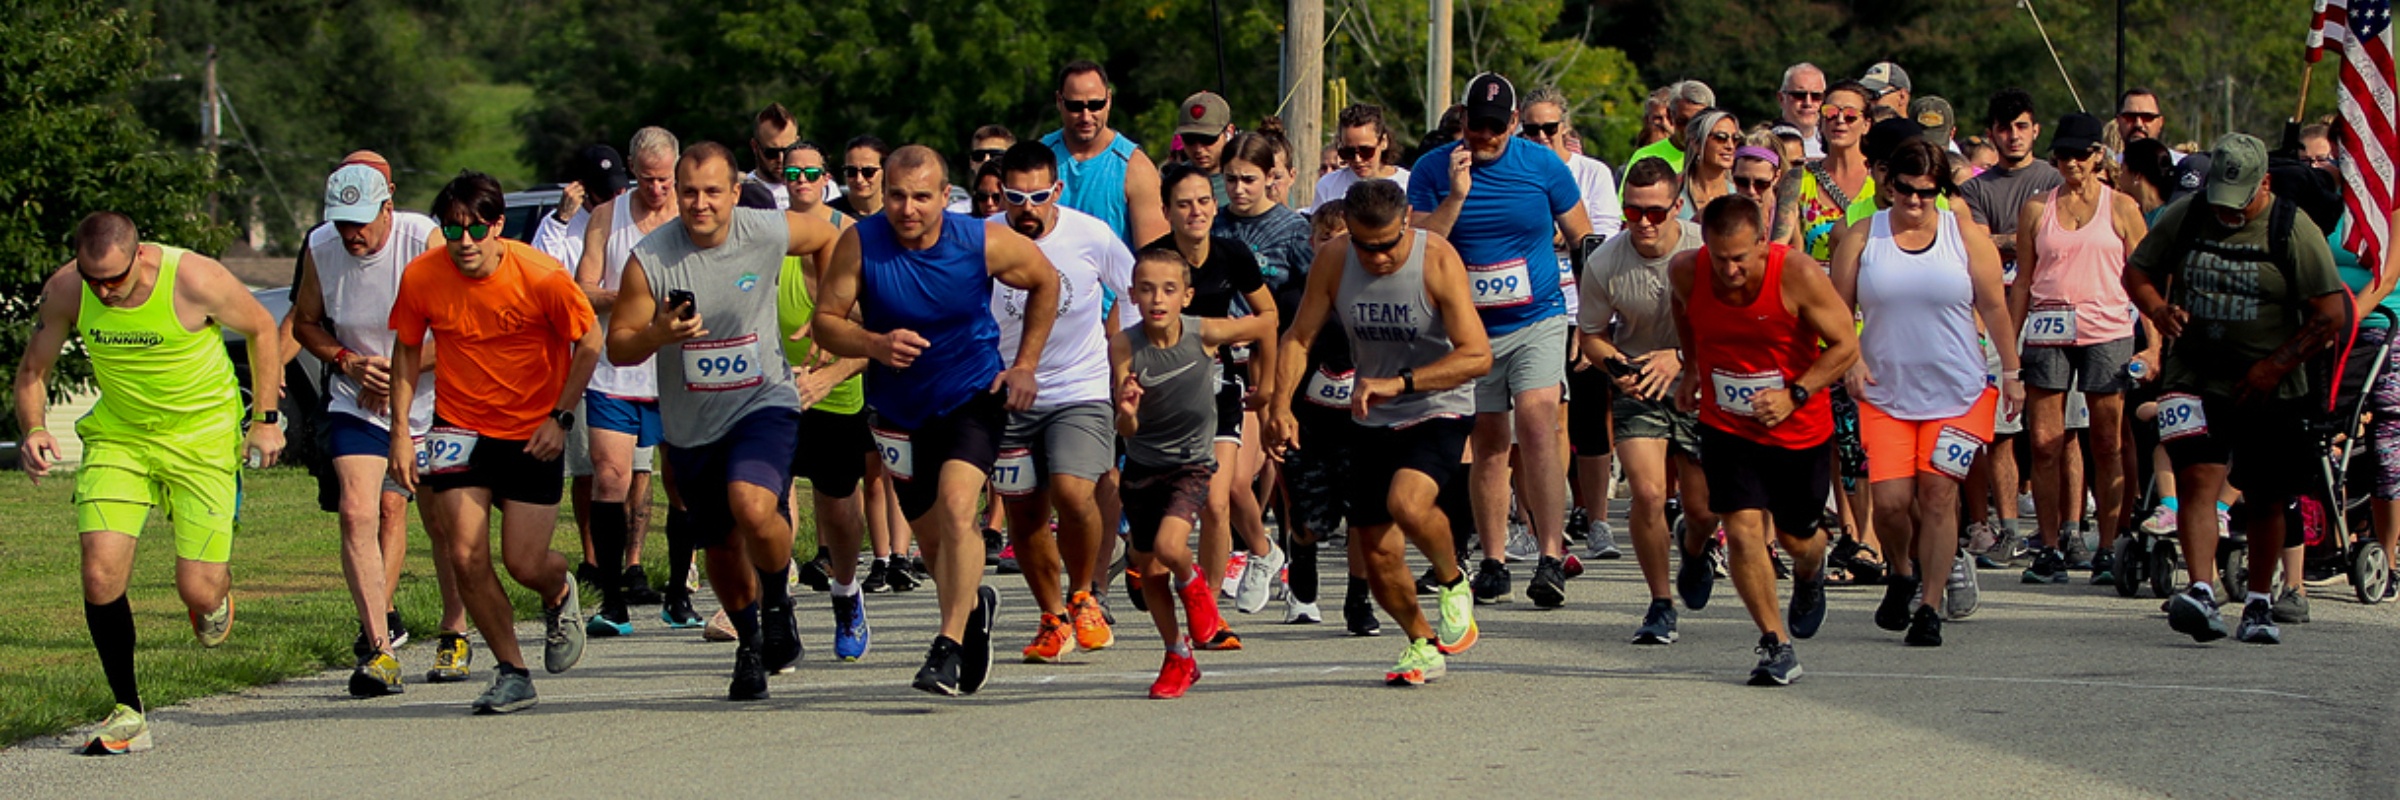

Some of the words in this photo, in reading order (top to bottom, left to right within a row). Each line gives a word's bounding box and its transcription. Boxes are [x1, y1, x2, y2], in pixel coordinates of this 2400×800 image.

[1475, 275, 1519, 297] 999
[1356, 303, 1409, 324] TEAM
[2184, 289, 2260, 321] FALLEN
[1352, 326, 1418, 343] HENRY
[2033, 316, 2065, 334] 975
[697, 353, 748, 377] 996
[1319, 384, 1352, 400] 85
[1724, 384, 1770, 404] 99
[991, 465, 1020, 484] 77
